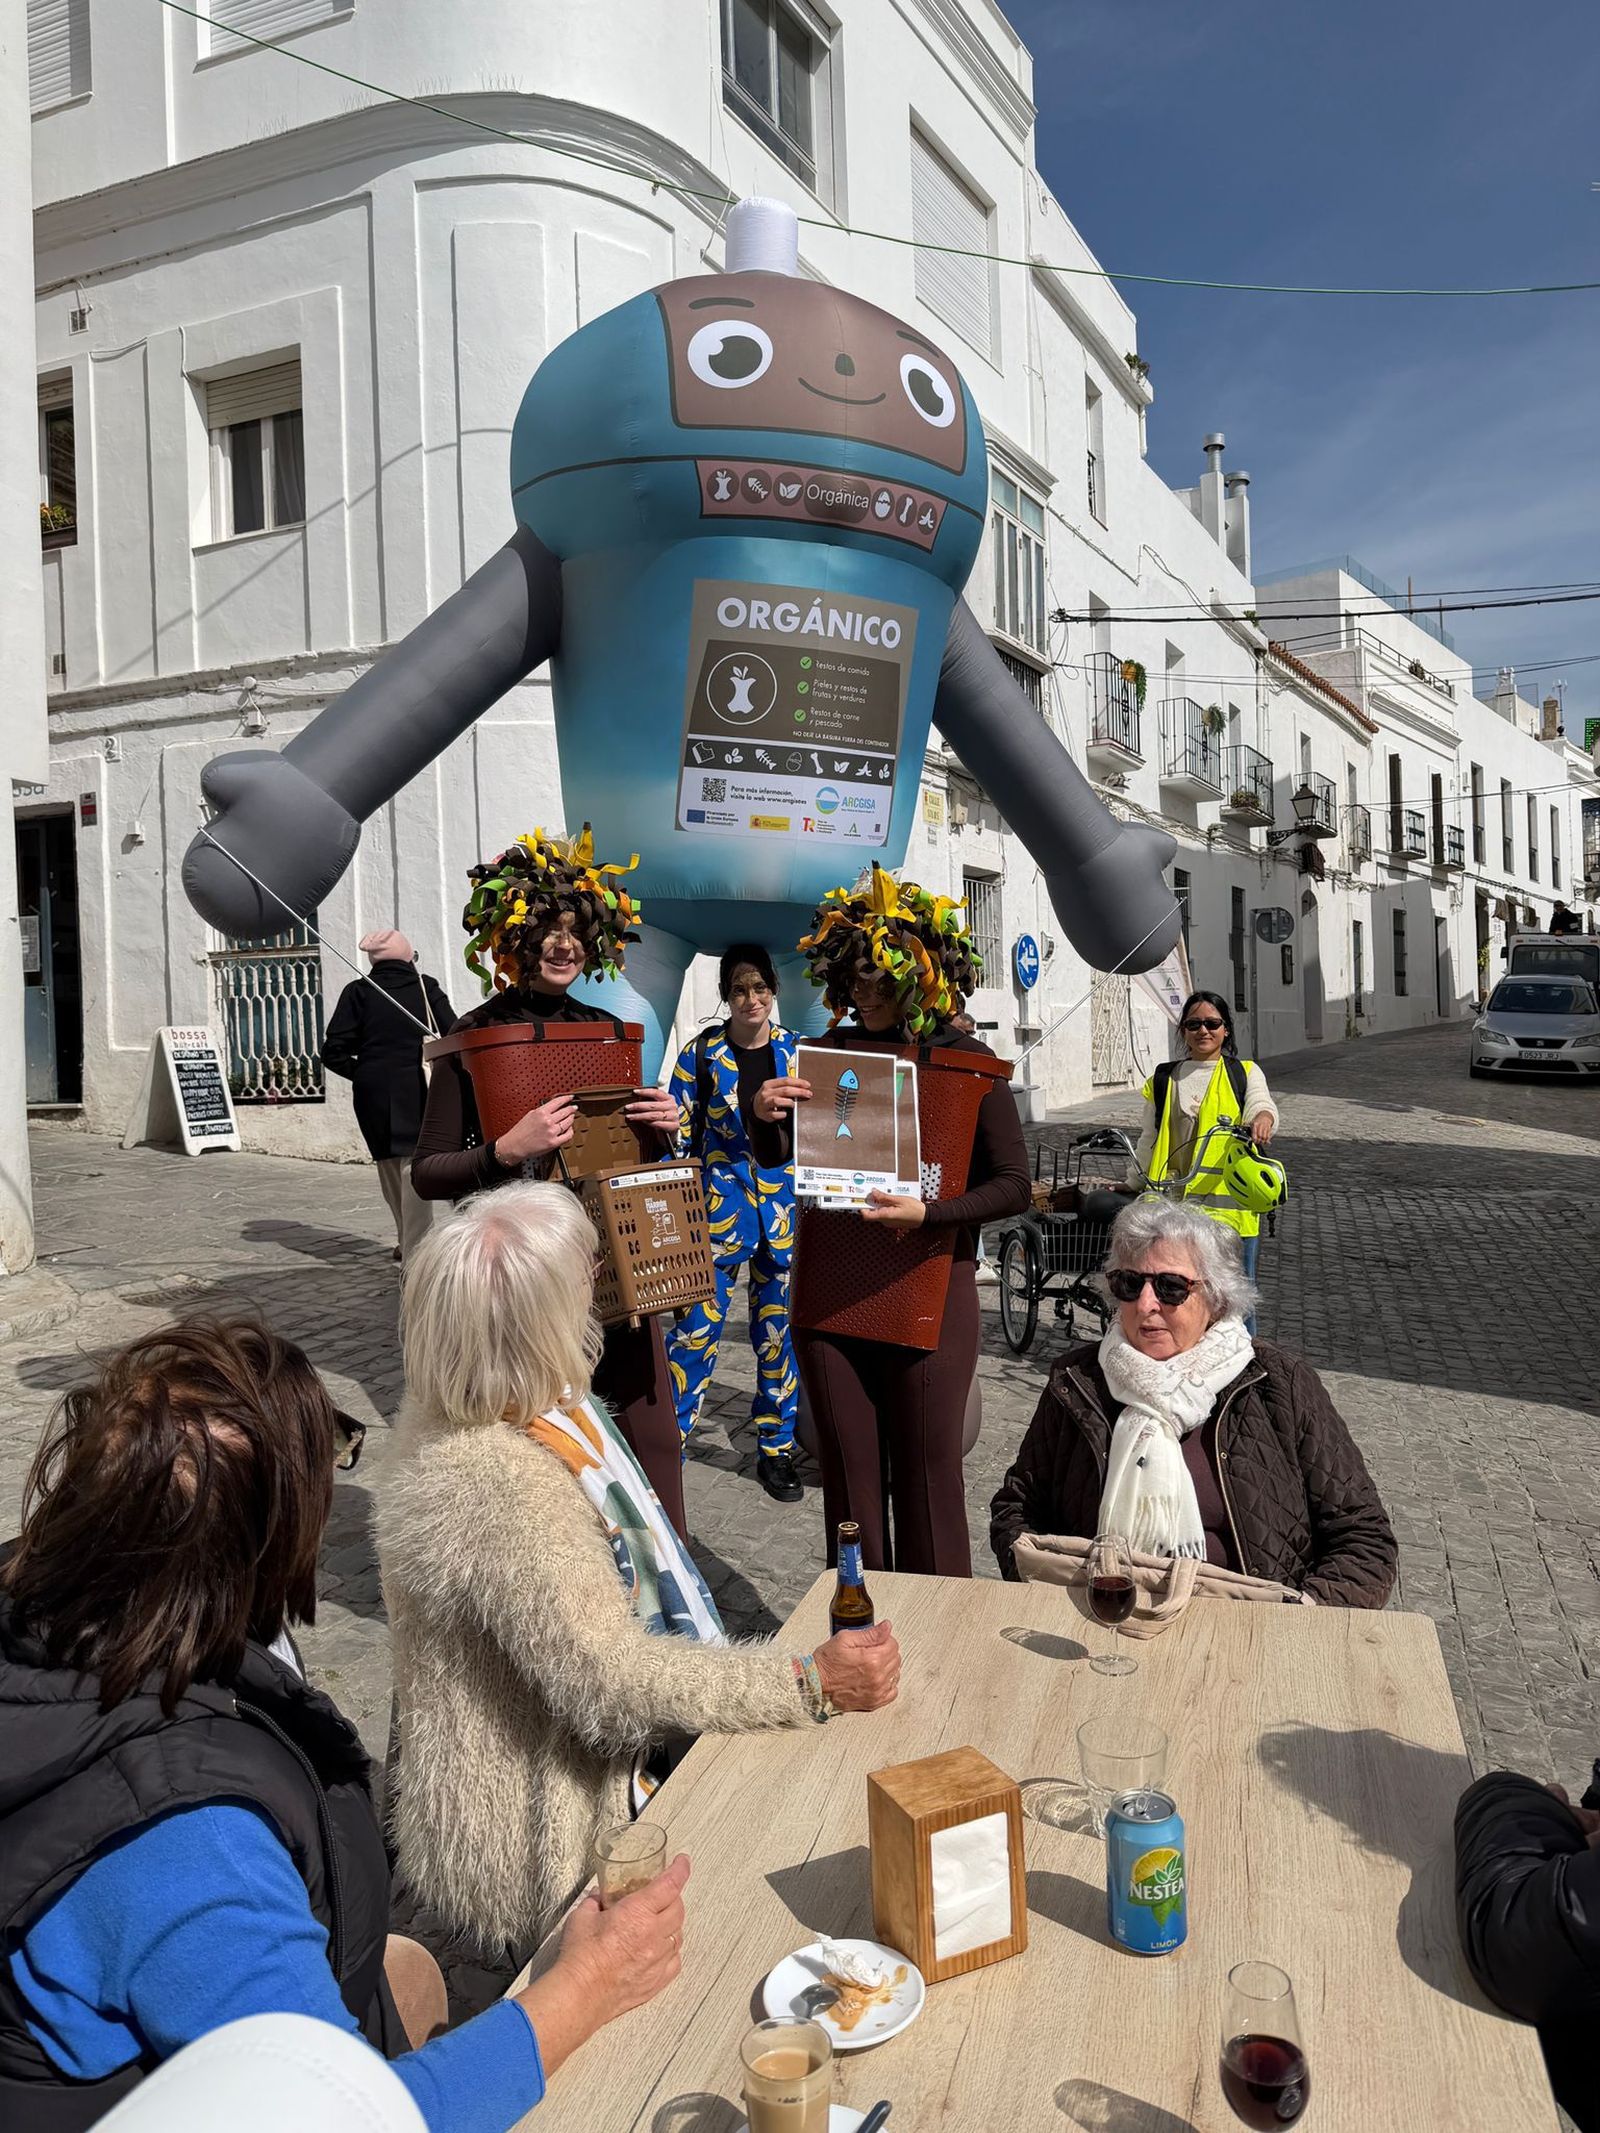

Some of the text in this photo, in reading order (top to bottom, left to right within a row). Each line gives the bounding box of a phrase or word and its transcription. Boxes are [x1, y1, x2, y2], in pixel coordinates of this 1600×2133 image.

[806, 484, 869, 510] Orgánica
[717, 597, 901, 648] ORGÁNICO
[815, 660, 835, 670] Restos
[837, 664, 846, 672] de
[813, 679, 832, 689] Pieles
[841, 685, 858, 693] restos
[860, 686, 867, 694] de
[812, 688, 831, 698] frutas
[810, 707, 831, 717] Restos
[833, 711, 841, 719] de
[815, 720, 843, 729] pescado
[841, 796, 876, 809] ARCGISA
[171, 1029, 207, 1040] bossa
[1129, 1878, 1185, 1900] NESTEA
